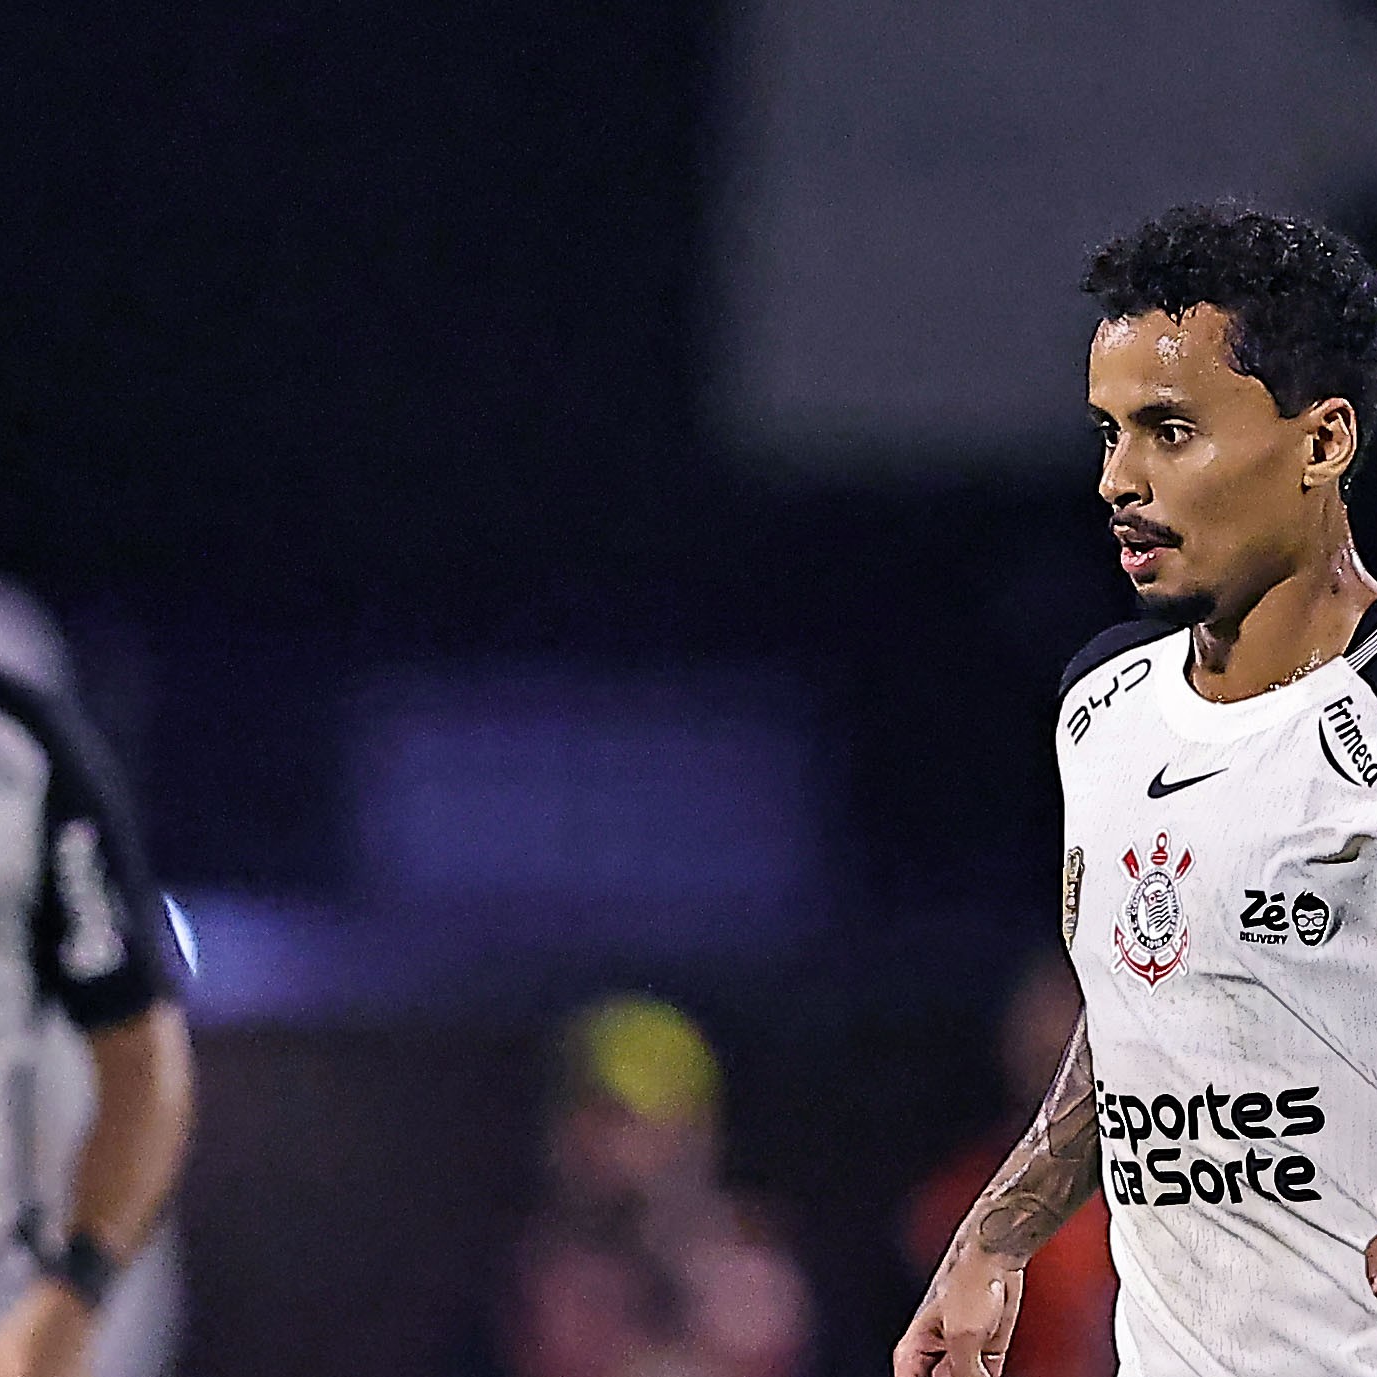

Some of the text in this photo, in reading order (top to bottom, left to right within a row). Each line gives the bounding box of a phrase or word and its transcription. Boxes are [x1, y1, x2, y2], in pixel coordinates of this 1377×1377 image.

[1239, 889, 1290, 932] Zé
[1239, 931, 1288, 945] DELIVERY
[1146, 1147, 1322, 1206] Sorte
